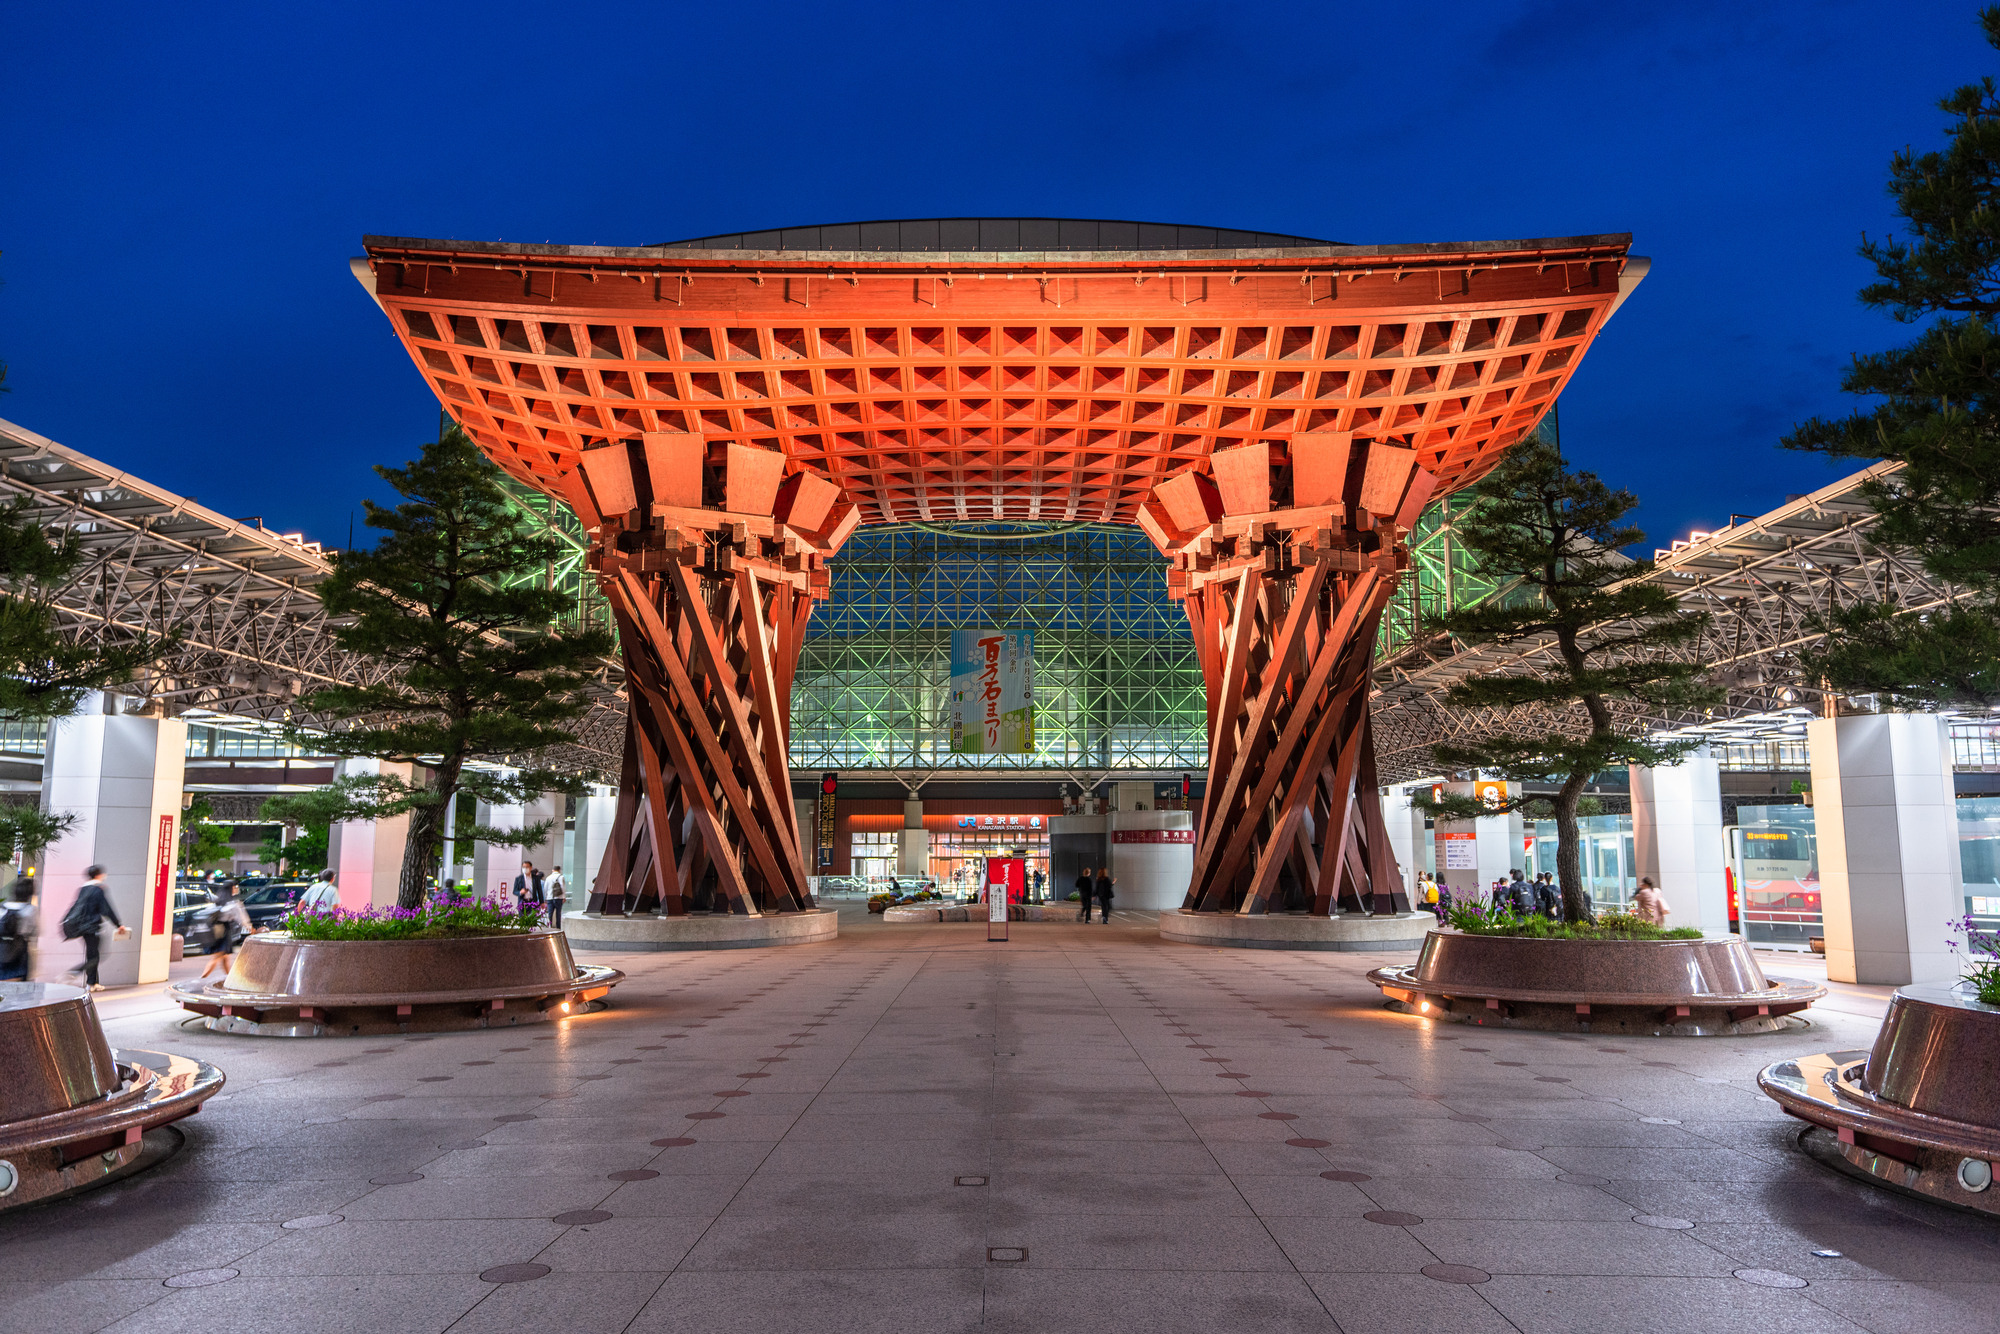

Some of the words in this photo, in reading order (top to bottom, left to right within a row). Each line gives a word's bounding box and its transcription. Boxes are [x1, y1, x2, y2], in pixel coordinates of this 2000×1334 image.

[976, 634, 1007, 748] 百万石まつり
[953, 711, 963, 750] 北國銀行
[959, 817, 976, 827] JR
[984, 816, 1019, 825] 金沢駅
